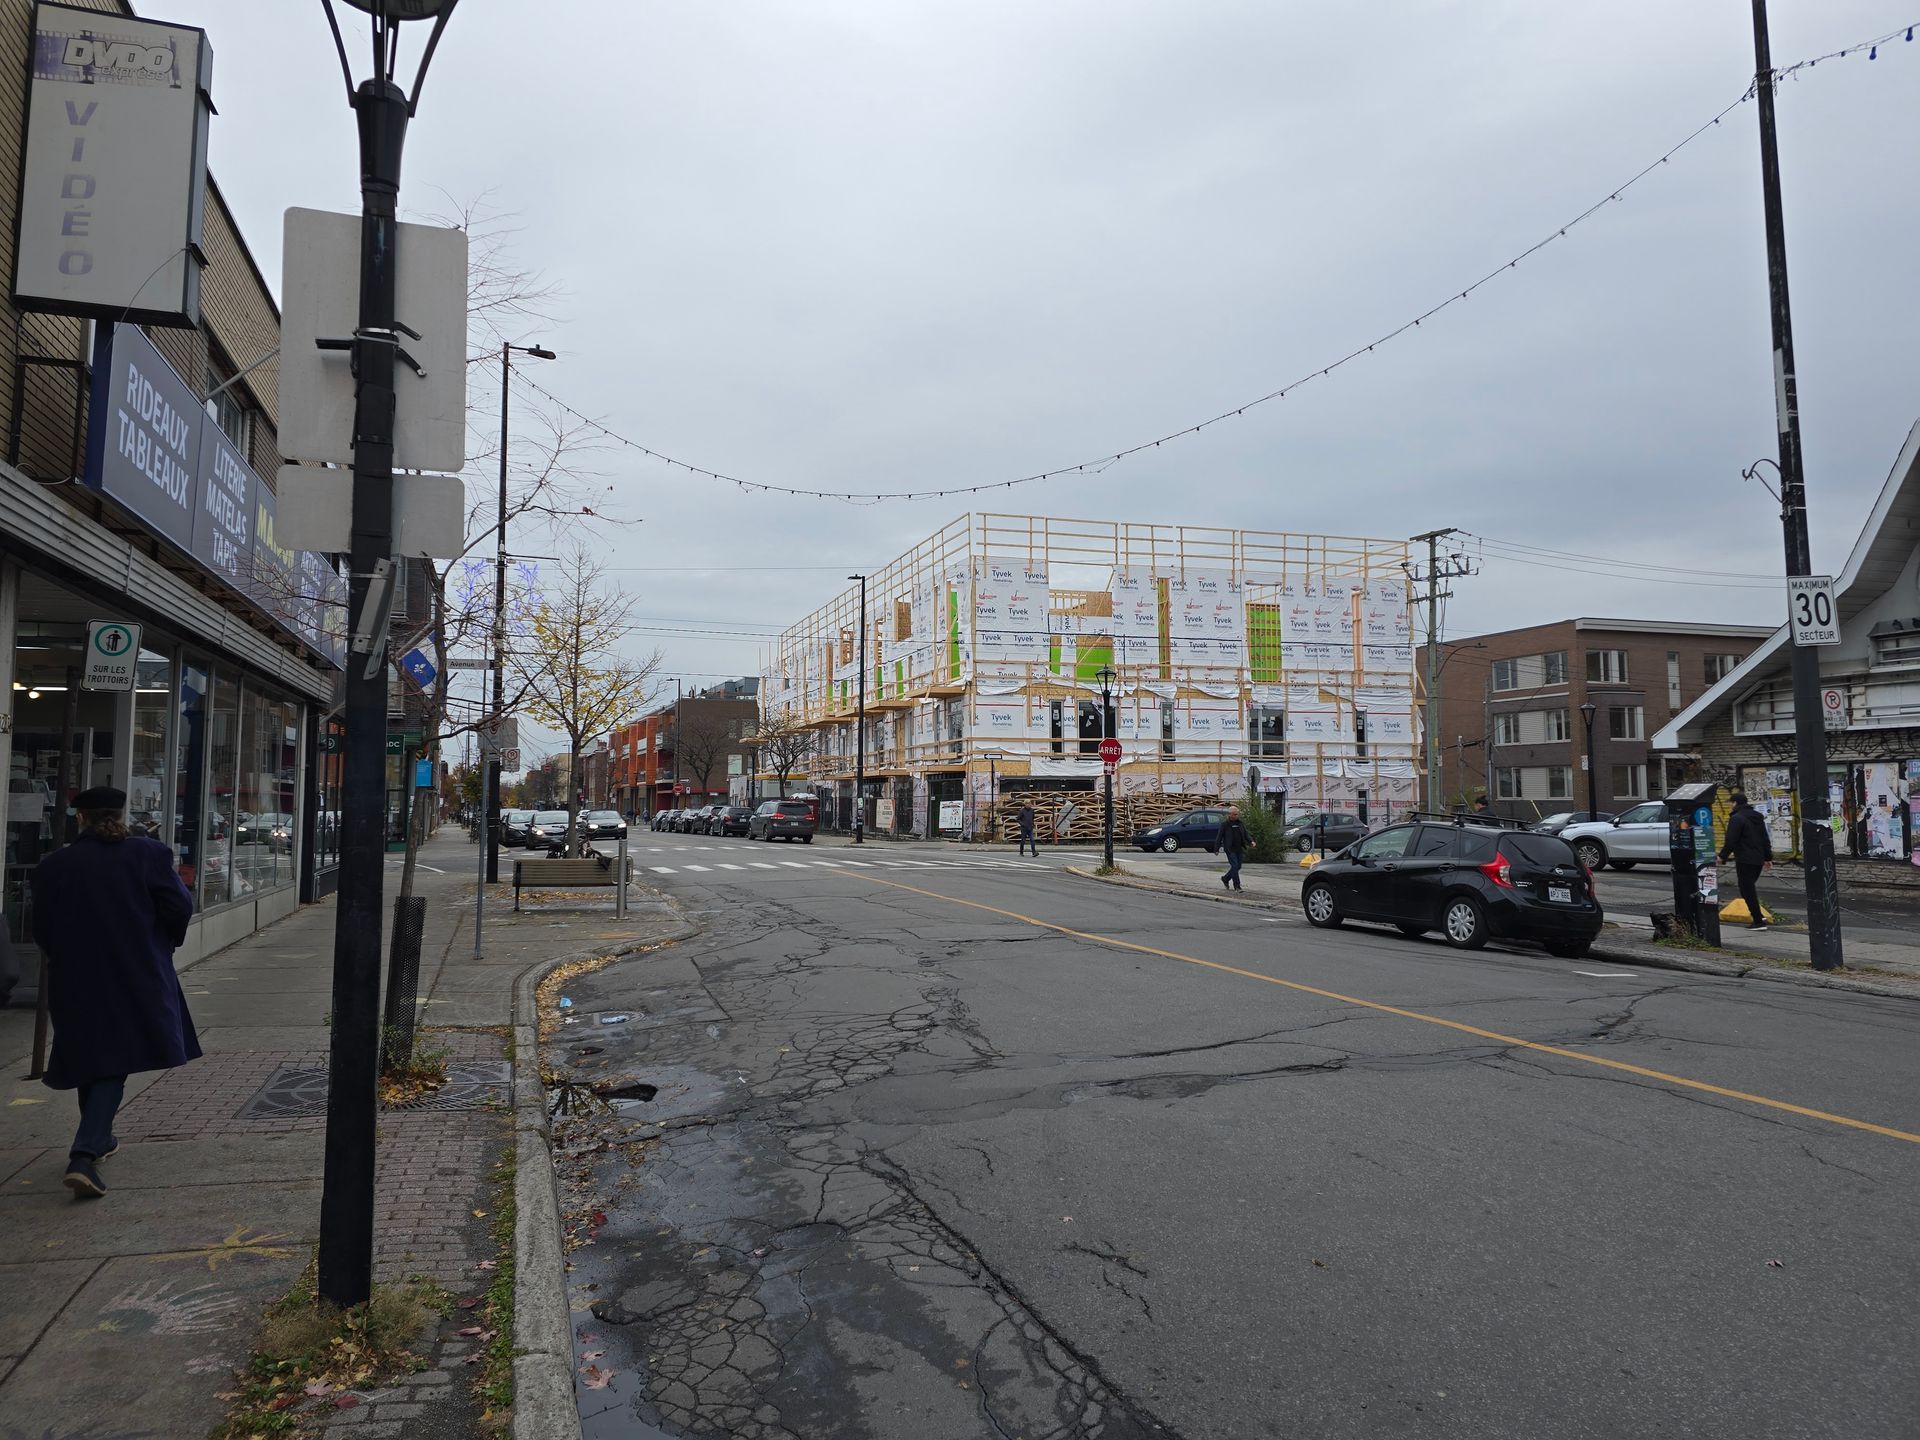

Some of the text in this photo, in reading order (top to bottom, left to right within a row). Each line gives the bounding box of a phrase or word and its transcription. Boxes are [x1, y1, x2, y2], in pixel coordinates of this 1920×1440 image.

[58, 100, 99, 276] VIDÉO
[126, 363, 189, 461] RIDEAUX
[118, 408, 189, 510] TABLEAUX
[214, 442, 247, 504] LITERIE
[205, 478, 247, 545] MATELAS
[992, 570, 1012, 579] Tyvek
[1791, 580, 1830, 590] MAXIMUM
[976, 606, 996, 614] Tyvek
[1008, 608, 1029, 616] Tyvek
[1795, 591, 1832, 627] 30
[1184, 615, 1203, 623] Tyvek
[1214, 616, 1232, 624] Tyvek
[1291, 620, 1308, 628] Tyvek
[1799, 630, 1835, 641] SECTEUR
[93, 664, 126, 674] SUR LES
[87, 674, 129, 685] TROTTOIRS
[1192, 717, 1210, 725] Tyvek
[1384, 721, 1401, 729] Tyvek
[1099, 746, 1122, 755] ARRÊT
